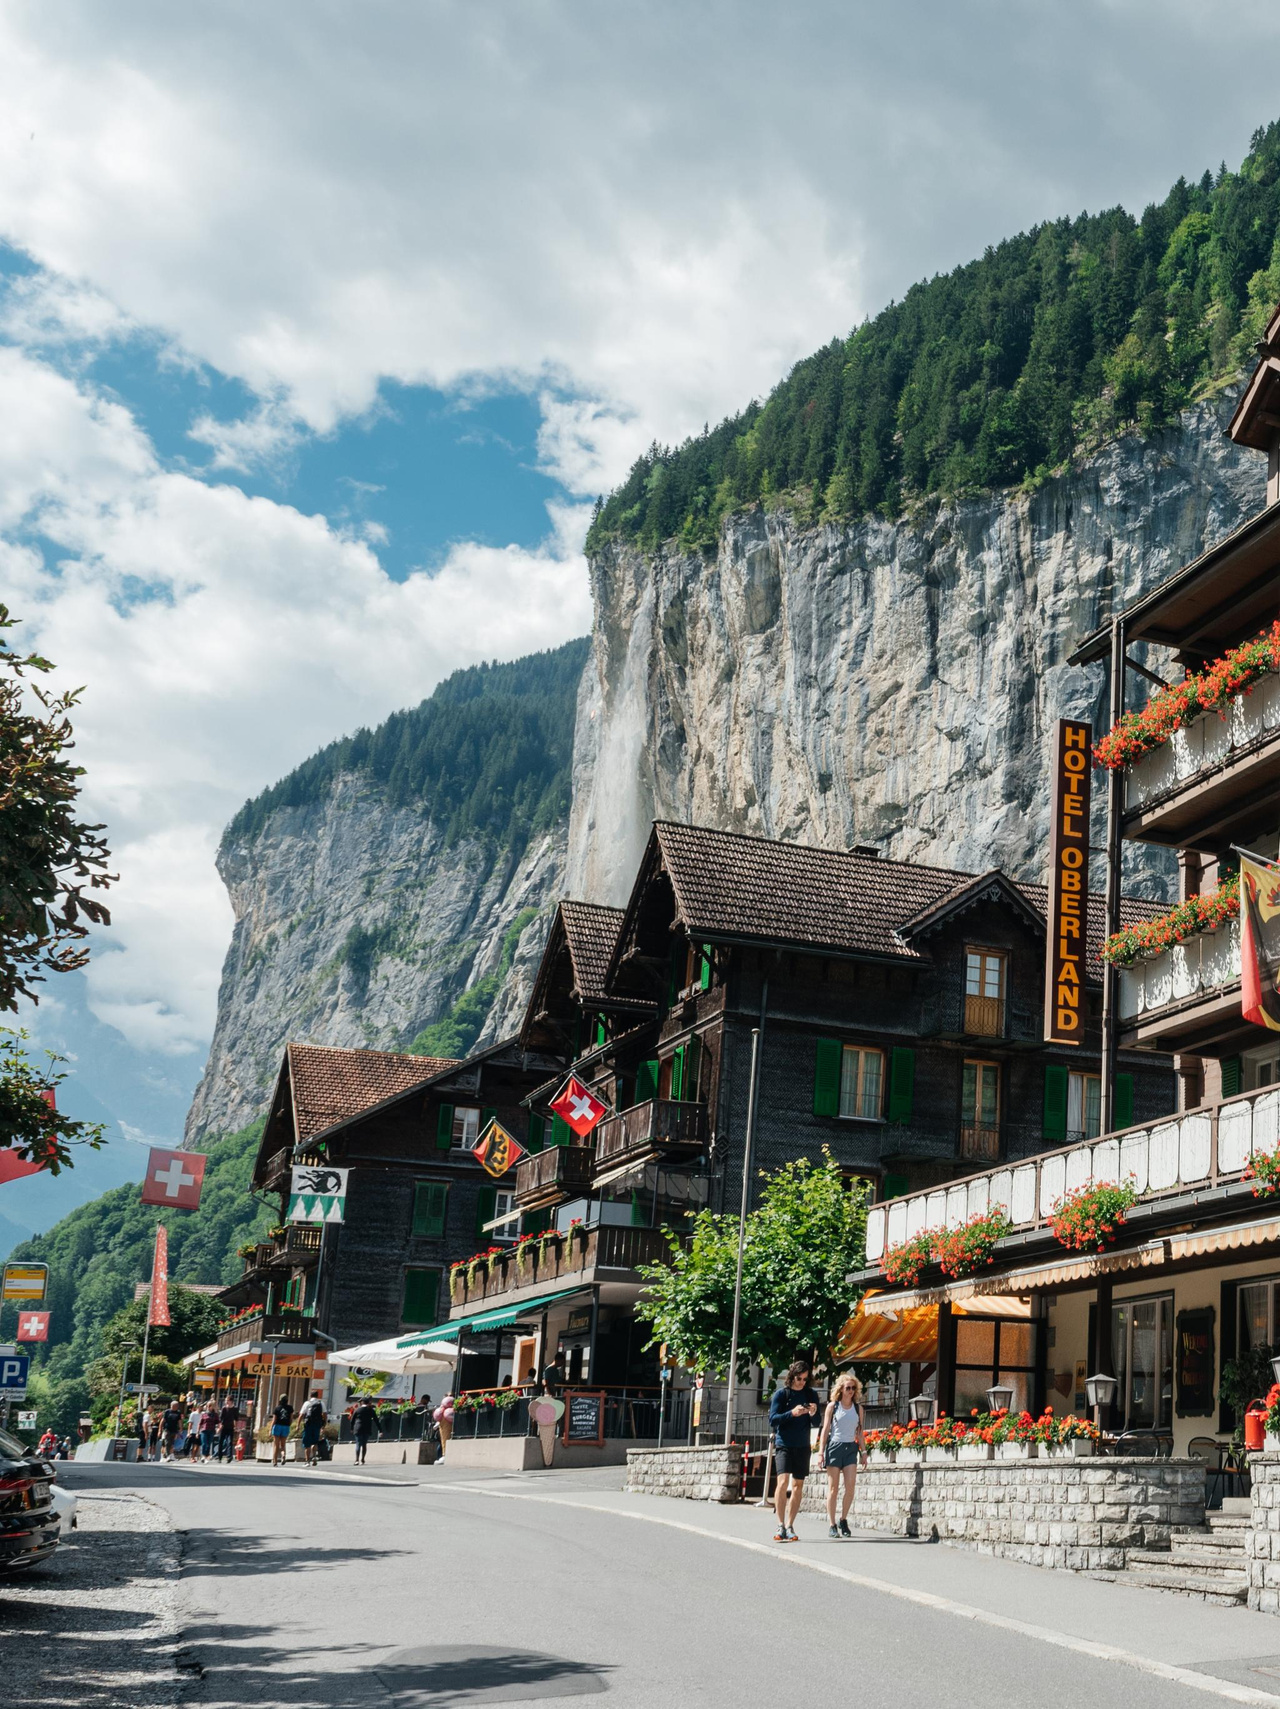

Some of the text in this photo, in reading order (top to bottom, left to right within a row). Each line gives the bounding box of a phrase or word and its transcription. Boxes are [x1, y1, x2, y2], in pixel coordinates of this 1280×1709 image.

[1057, 726, 1086, 1031] HOTEL OBERLAND
[2, 1360, 21, 1384] P
[286, 1365, 309, 1377] BAR
